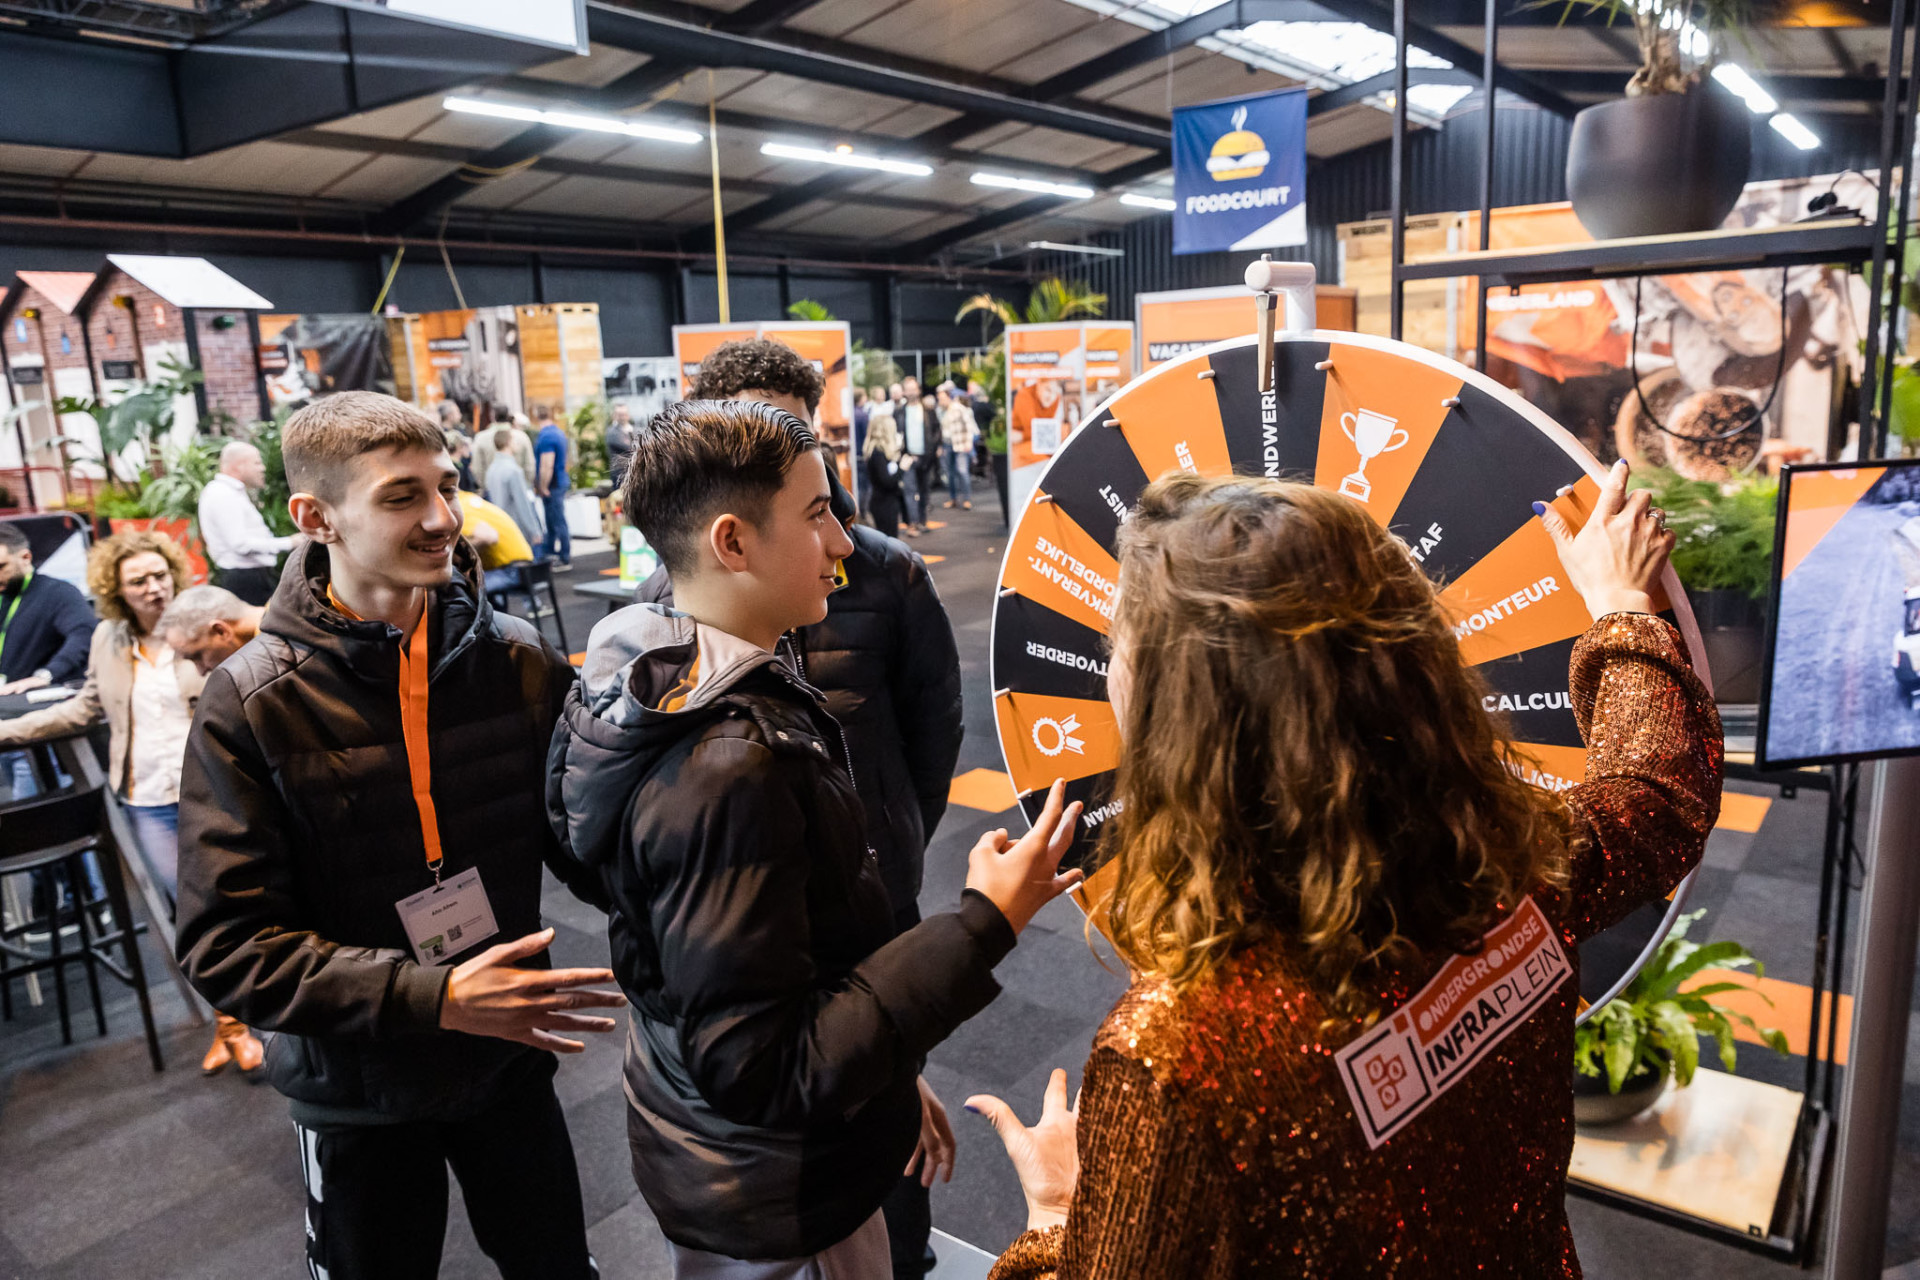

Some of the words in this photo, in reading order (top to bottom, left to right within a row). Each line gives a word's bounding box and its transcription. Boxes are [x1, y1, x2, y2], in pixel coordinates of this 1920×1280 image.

[1185, 185, 1291, 216] FOODCOURT
[1409, 521, 1443, 571] TAF
[1450, 575, 1561, 642] MONTEUR
[1418, 915, 1541, 1032] ONDERGRONDSE
[1424, 939, 1562, 1078] INFRAPLEIN
